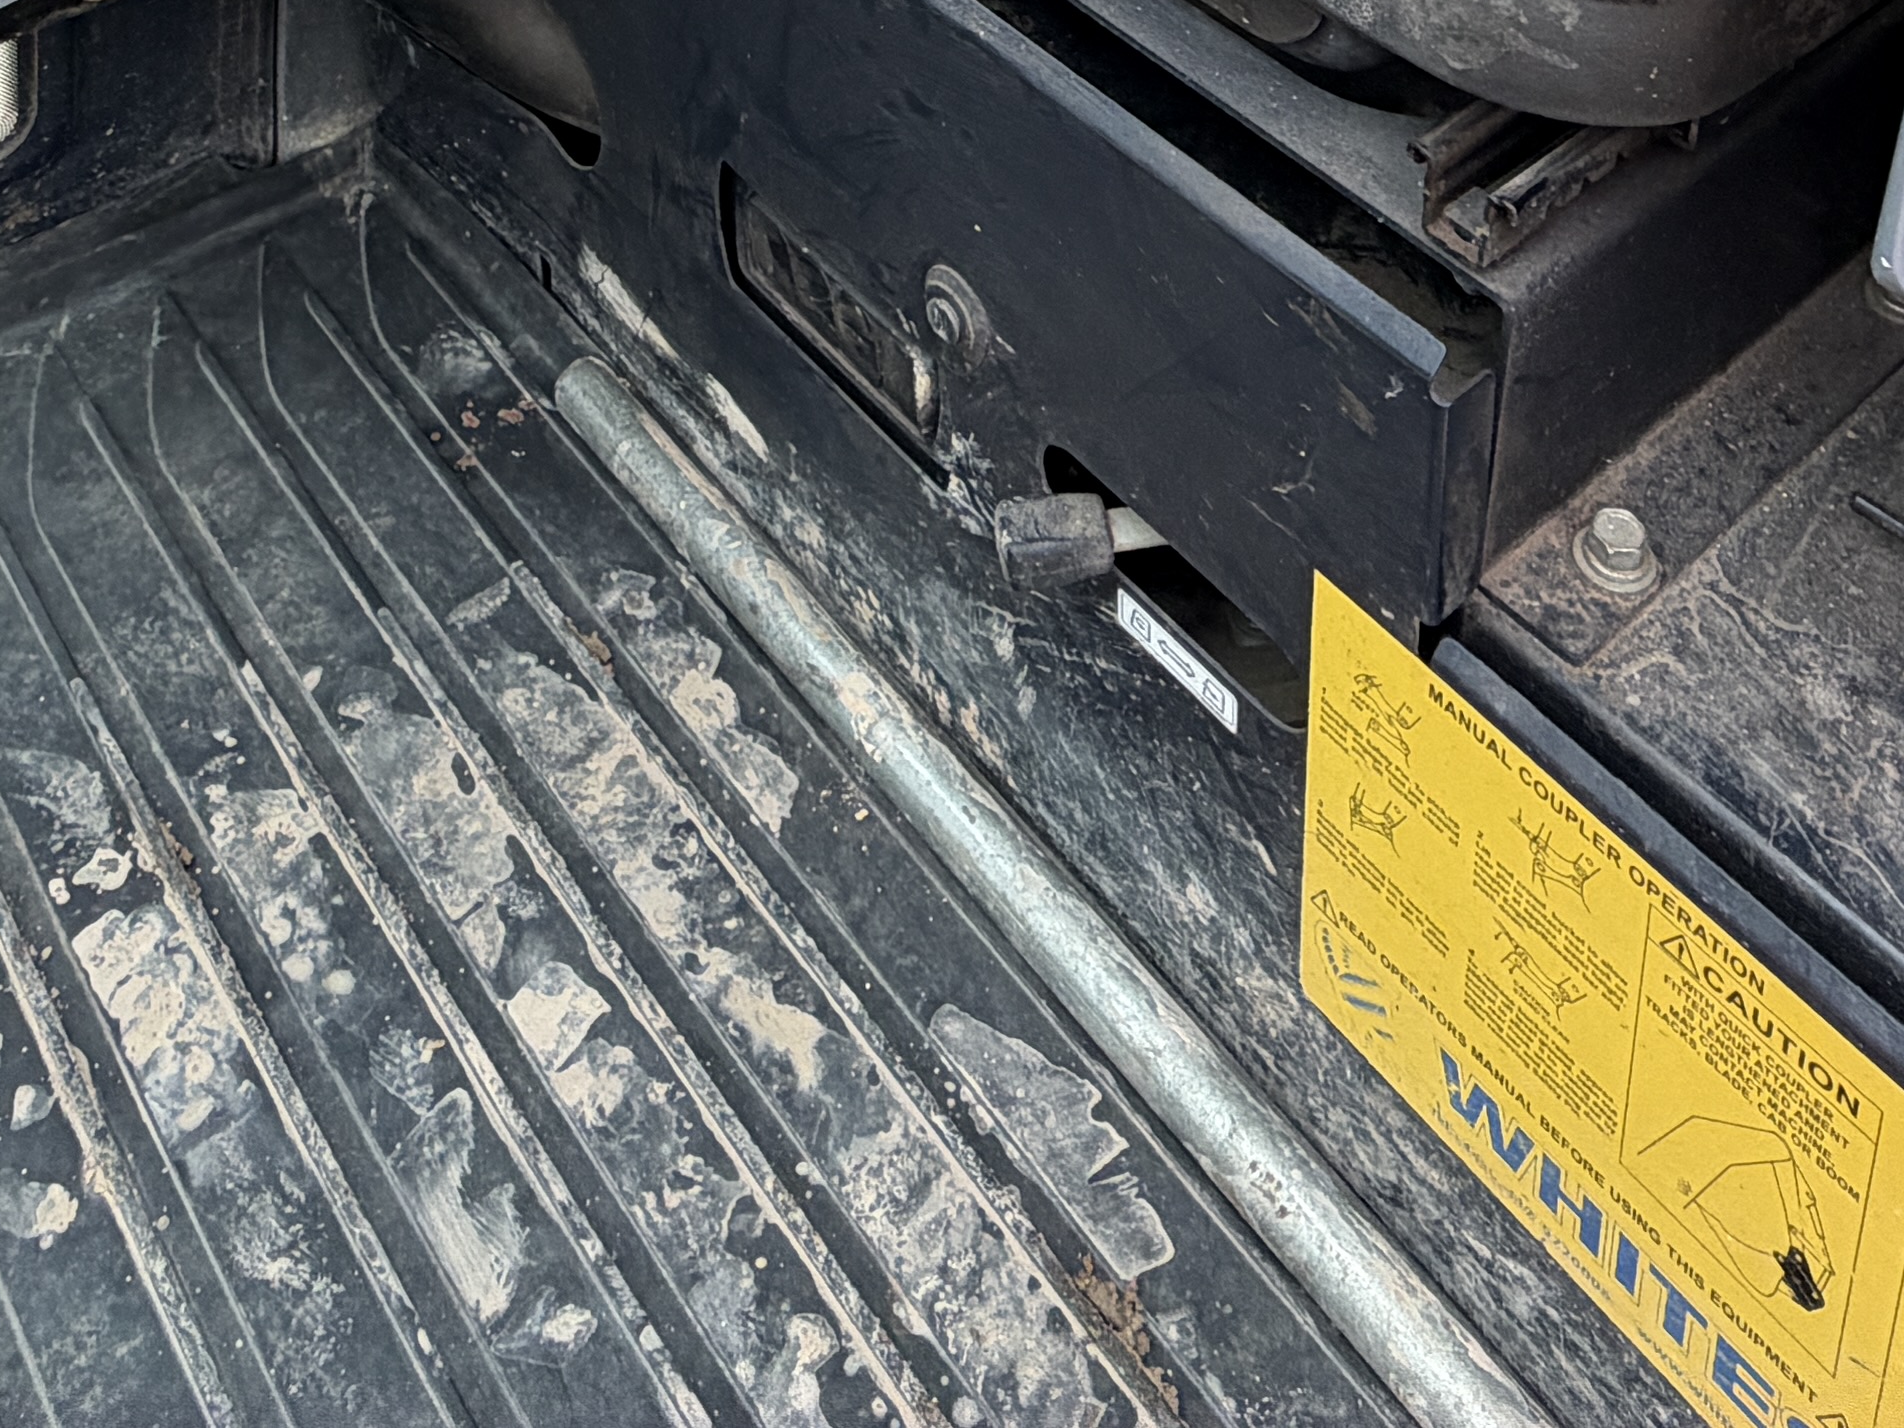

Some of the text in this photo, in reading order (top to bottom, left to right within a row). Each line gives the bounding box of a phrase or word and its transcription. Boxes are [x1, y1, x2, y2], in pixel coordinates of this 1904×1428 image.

[1428, 680, 1766, 999] MANUAL COUPLER OPERATION
[1645, 995, 1860, 1204] TRACKS, BLADE, CAB OR BOOM
[1663, 972, 1850, 1152] FITTED YOUR ATTACHMENT
[1668, 1003, 1836, 1168] MAY CONTACT MACHINE,
[1680, 974, 1834, 1123] WITH QUICK COUPLER
[1682, 1002, 1825, 1143] IS LENGTHENED AND
[1701, 960, 1861, 1120] CAUTION
[1339, 909, 1376, 958] READ
[1380, 950, 1467, 1050] OPERATORS
[1471, 1042, 1535, 1119] MANUAL
[1539, 1112, 1605, 1190] BEFORE
[1609, 1184, 1661, 1248] USING
[1666, 1241, 1705, 1292] THIS
[1708, 1285, 1818, 1407] EQUIPMENT
